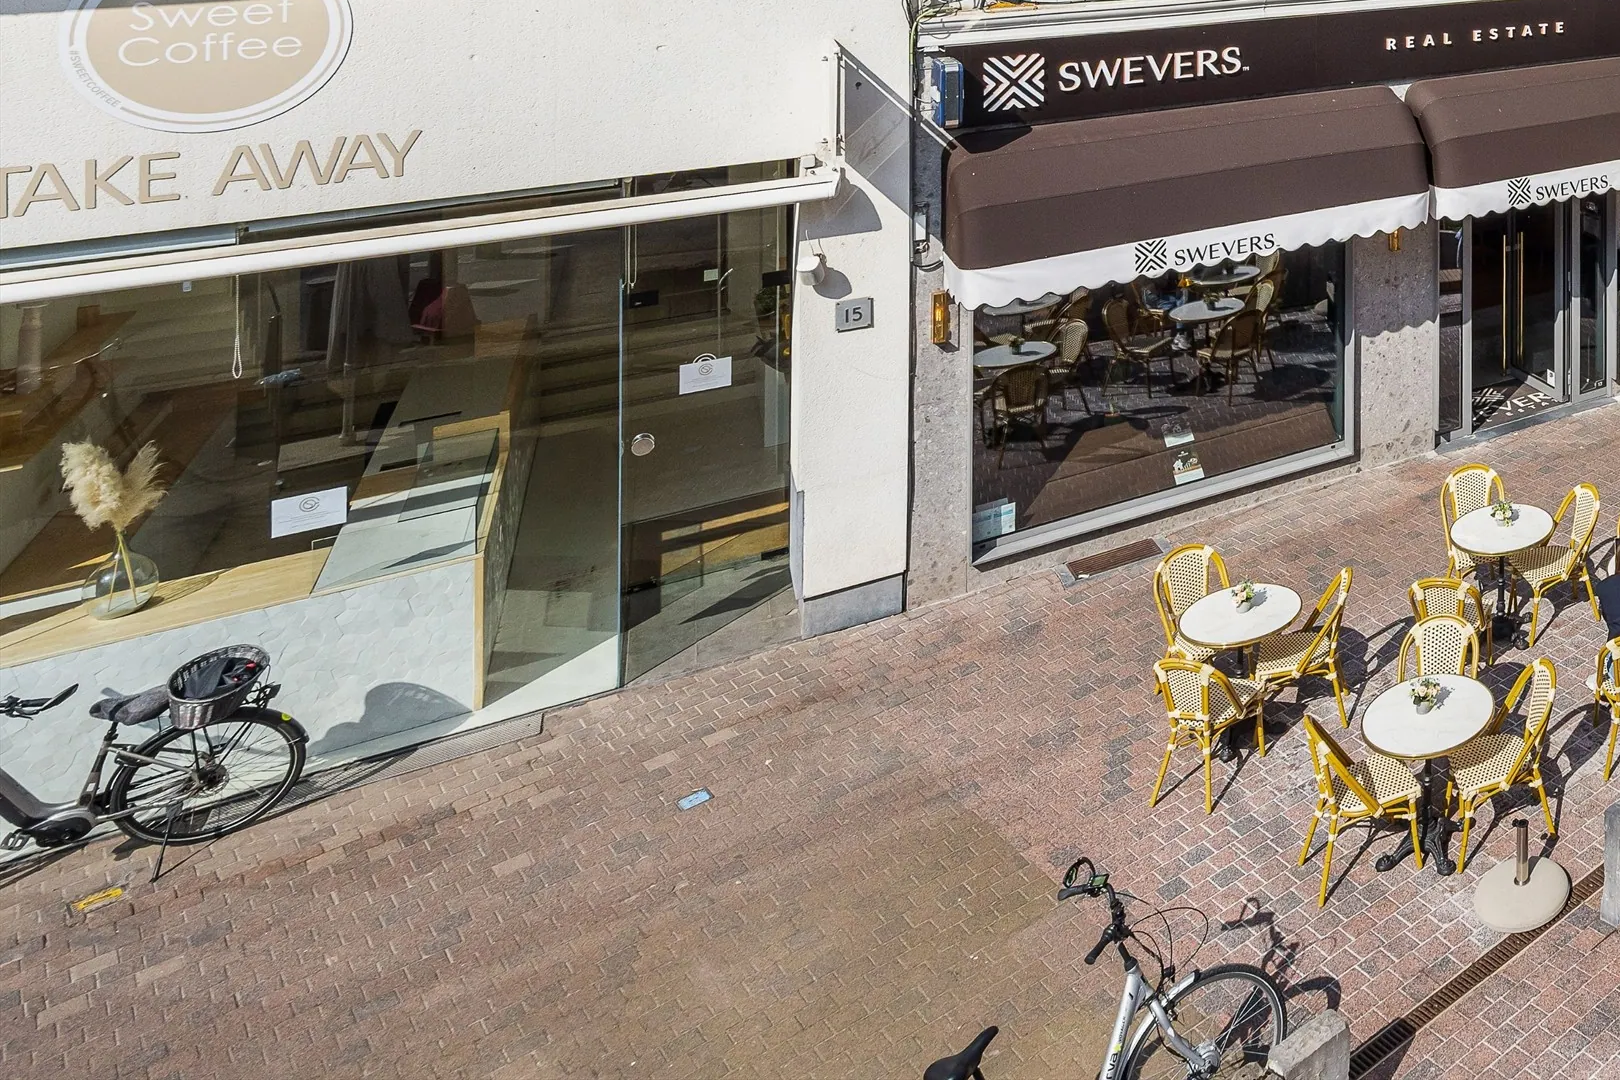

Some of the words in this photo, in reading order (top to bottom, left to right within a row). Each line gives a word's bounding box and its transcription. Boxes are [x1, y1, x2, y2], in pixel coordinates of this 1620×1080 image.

[118, 31, 303, 67] Coffee
[1385, 32, 1452, 51] REAL
[1472, 21, 1565, 42] ESTATE
[69, 50, 122, 109] #SWEETCOFFEE
[1058, 46, 1243, 93] SWEVERS
[211, 129, 423, 197] AWAY
[1535, 174, 1610, 202] SWEVERS
[1173, 233, 1276, 267] SWEVERS
[844, 306, 863, 324] 15
